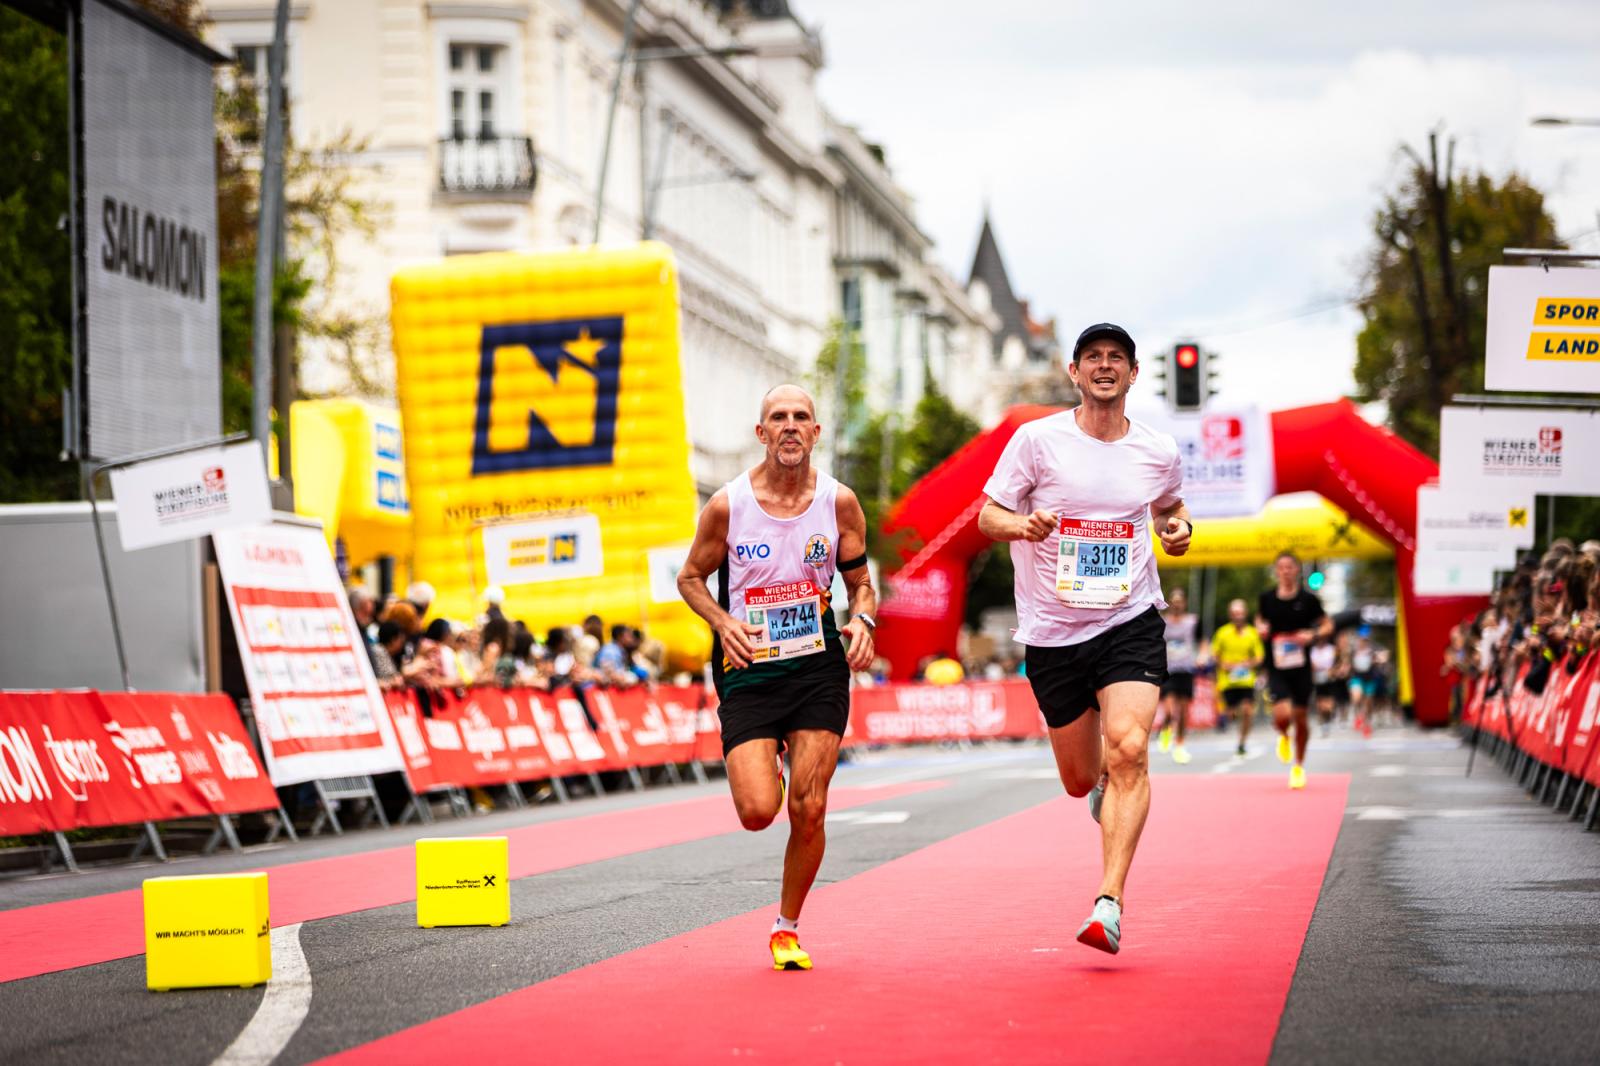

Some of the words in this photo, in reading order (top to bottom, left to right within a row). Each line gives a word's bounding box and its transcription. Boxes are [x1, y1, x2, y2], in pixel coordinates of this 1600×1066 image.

[102, 195, 206, 304] SALOMON
[1544, 304, 1600, 320] SPOR
[1543, 339, 1600, 355] LAND
[1080, 520, 1113, 530] WIENER
[736, 543, 771, 560] PVO
[1080, 554, 1088, 564] H
[1091, 545, 1127, 566] 3118
[1084, 566, 1121, 577] PHILIPP
[764, 583, 798, 595] WIENER
[771, 619, 779, 630] H
[780, 603, 816, 628] 2744
[775, 625, 814, 641] JOHANN
[155, 931, 171, 939] WIR
